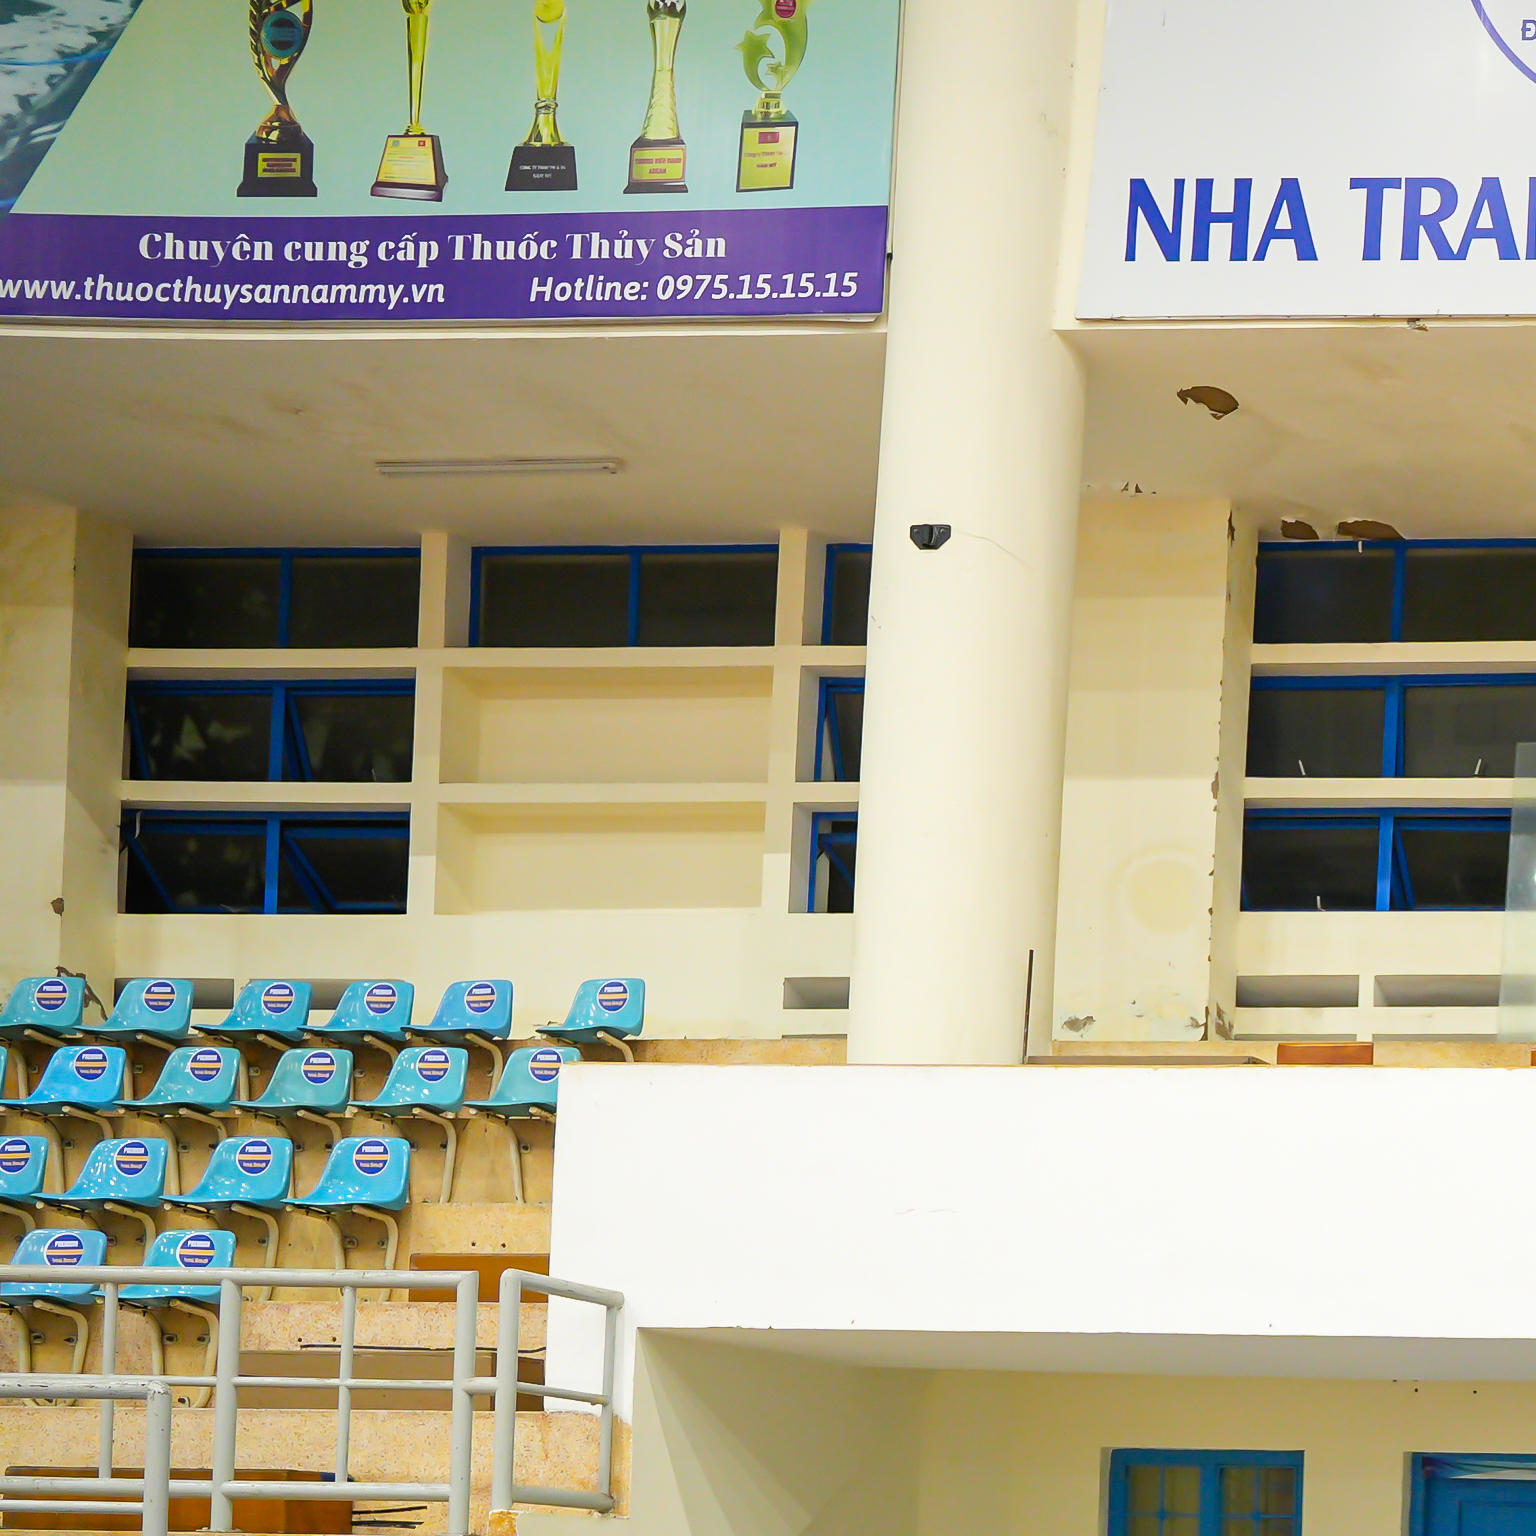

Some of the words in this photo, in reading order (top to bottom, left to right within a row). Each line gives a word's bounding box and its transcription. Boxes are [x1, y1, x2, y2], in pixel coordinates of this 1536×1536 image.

[1124, 177, 1319, 262] NHA
[139, 232, 274, 268] Chuyên
[284, 239, 370, 269] cung
[377, 232, 439, 268] cấp
[447, 231, 558, 261] Thuốc
[565, 229, 657, 264] Thủy
[662, 228, 726, 259] Sản
[0, 274, 446, 310] www.thuocthuysannammy.vn
[529, 274, 649, 302] Hotline:
[656, 272, 859, 301] 0975.15.15.15
